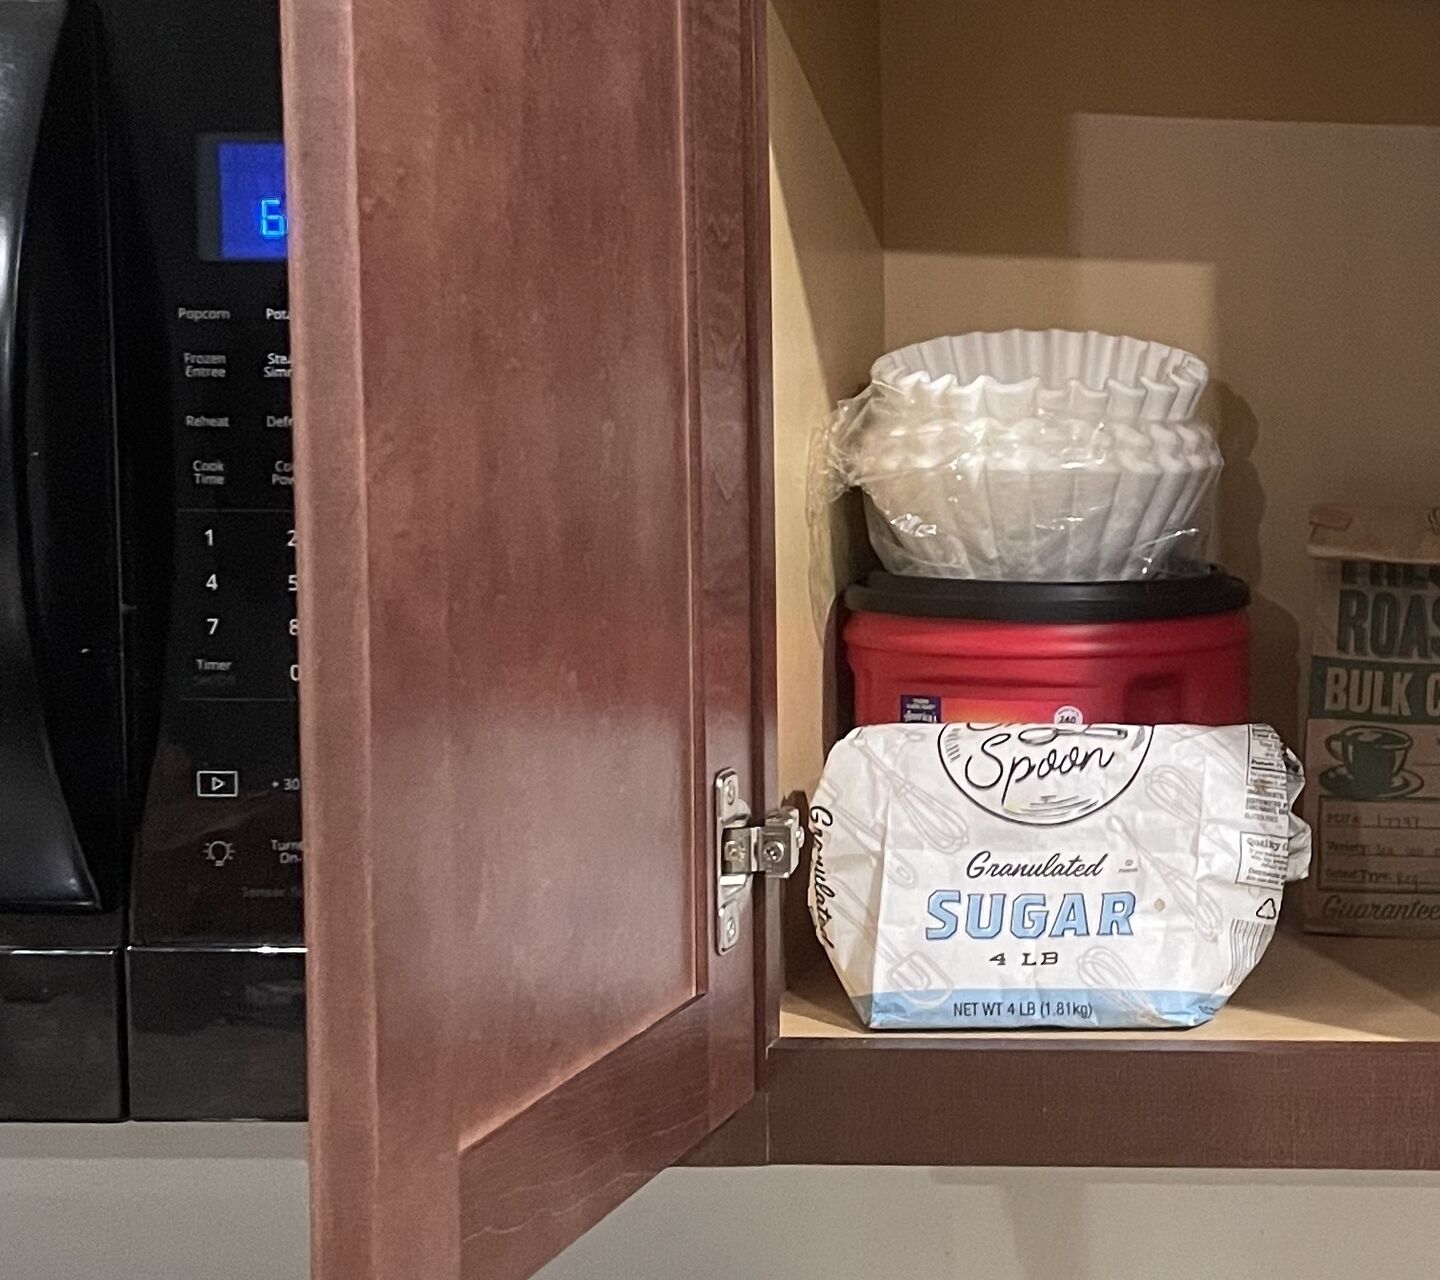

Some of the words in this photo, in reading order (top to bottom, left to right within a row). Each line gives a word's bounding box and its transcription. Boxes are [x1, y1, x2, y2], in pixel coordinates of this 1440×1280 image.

[178, 307, 231, 321] Popcorn
[184, 352, 226, 365] Frozen
[185, 365, 226, 378] Entree
[185, 415, 230, 428] Reheat
[193, 460, 224, 472] Cook
[194, 473, 225, 486] Time
[204, 528, 214, 548] 1
[286, 529, 296, 548] 2
[205, 573, 219, 591] 4
[288, 574, 298, 592] 5
[206, 618, 220, 635] 7
[196, 658, 233, 671] Timer
[1324, 666, 1413, 717] BULK
[964, 733, 1115, 806] Spoon
[966, 850, 1109, 879] Granulated
[925, 889, 1137, 941] SUGAR
[989, 952, 1007, 966] 4
[1021, 951, 1059, 966] LB
[953, 1001, 979, 1018] NET
[981, 1001, 1002, 1017] WT
[1006, 1001, 1016, 1017] 4
[1019, 1001, 1036, 1018] LB
[1039, 1001, 1093, 1020] (1.81kg)
